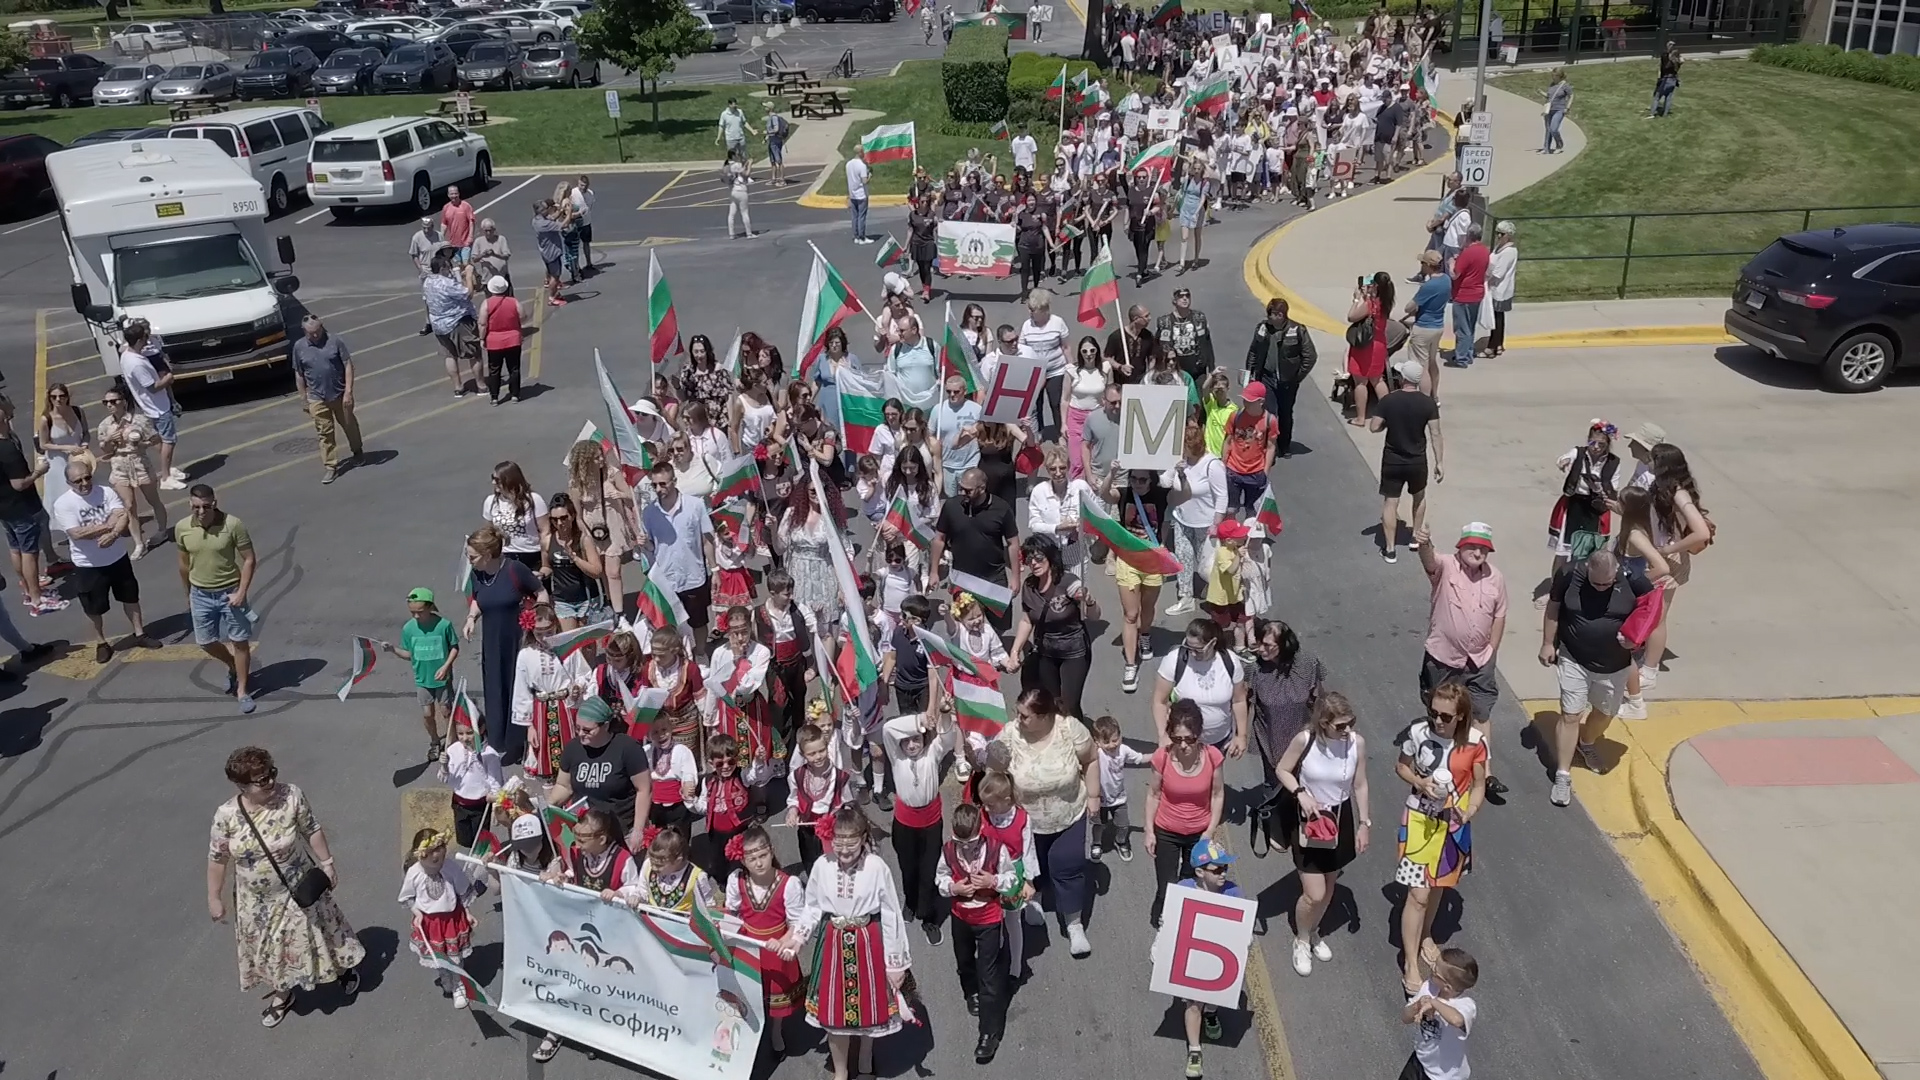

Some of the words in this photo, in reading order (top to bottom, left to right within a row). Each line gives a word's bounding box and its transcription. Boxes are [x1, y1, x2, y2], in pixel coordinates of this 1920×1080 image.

[1465, 167, 1485, 182] 10
[576, 762, 612, 782] GAP
[1169, 897, 1245, 992] Б
[525, 955, 601, 995] Българско
[606, 984, 679, 1016] Училище
